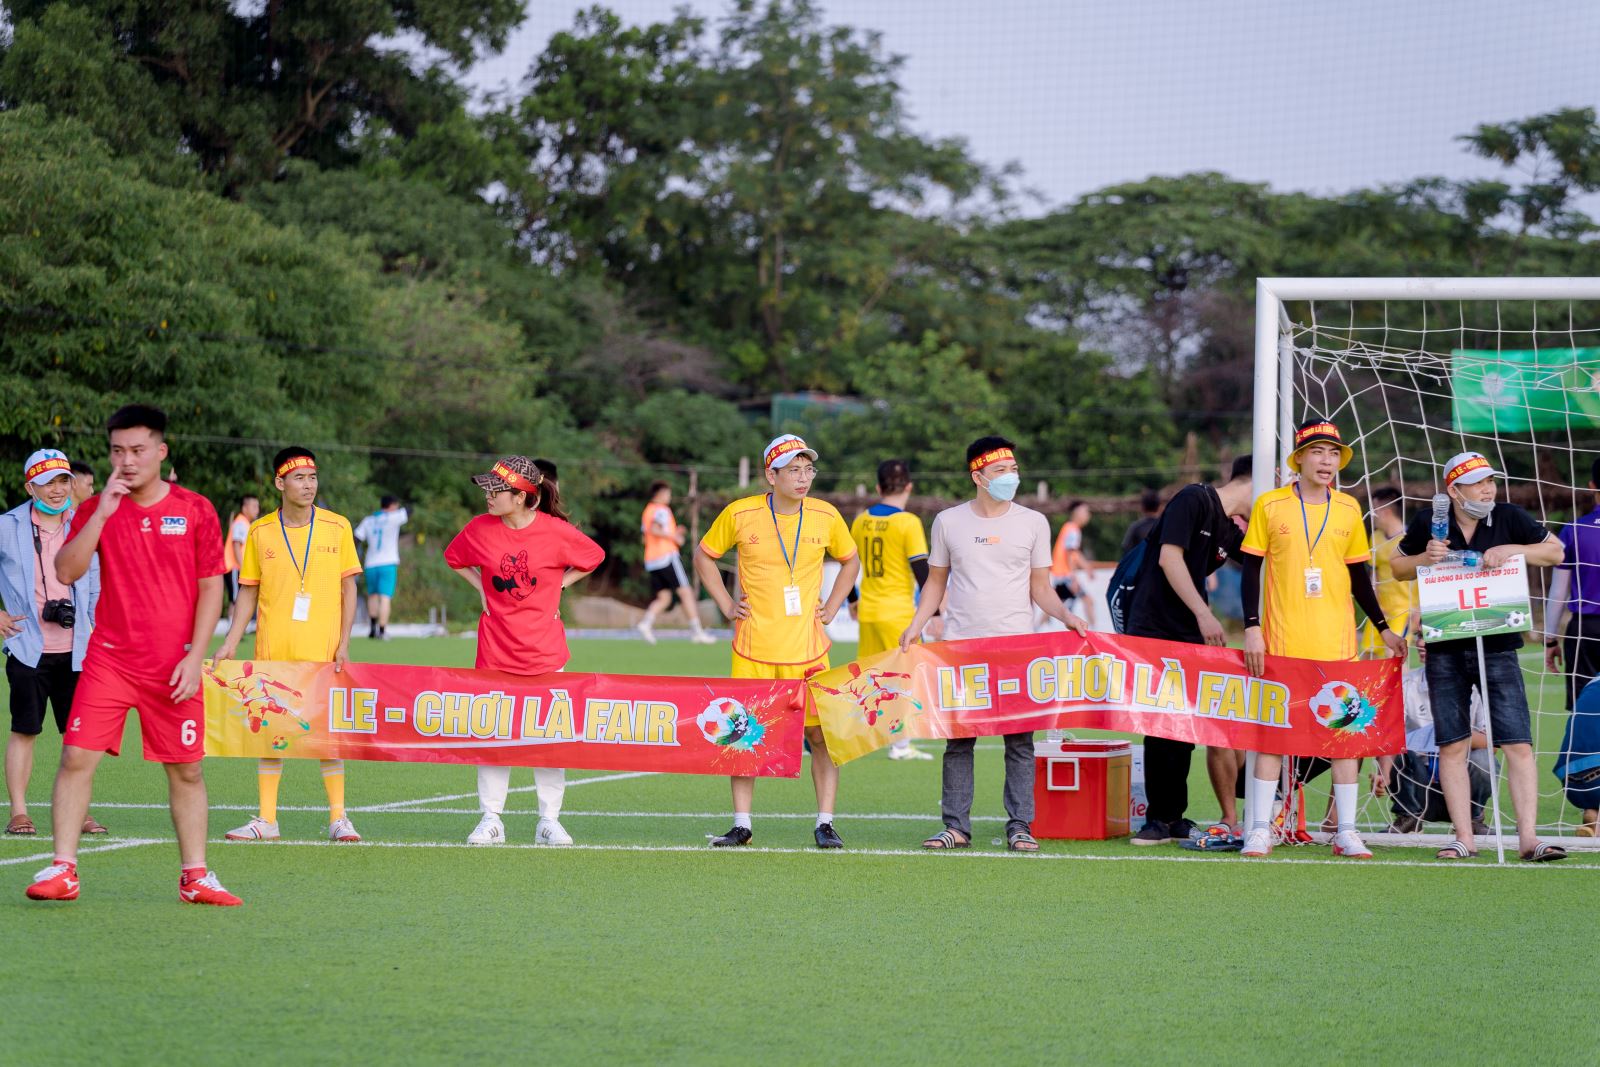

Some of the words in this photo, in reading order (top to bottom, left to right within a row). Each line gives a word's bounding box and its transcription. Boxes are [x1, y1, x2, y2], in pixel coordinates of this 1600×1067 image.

[864, 536, 884, 578] 18
[1475, 570, 1490, 579] OPEN
[1491, 569, 1502, 577] CUP
[1503, 567, 1519, 576] 2022
[1457, 586, 1489, 611] LE
[937, 662, 992, 711] LE
[1027, 652, 1126, 704] CHƠI
[1132, 657, 1188, 713] LÀ
[1196, 671, 1292, 728] FAIR
[181, 719, 197, 746] 6
[329, 688, 378, 734] LE
[413, 690, 516, 739] CHƠI
[521, 689, 575, 741] LÀ
[582, 698, 681, 746] FAIR
